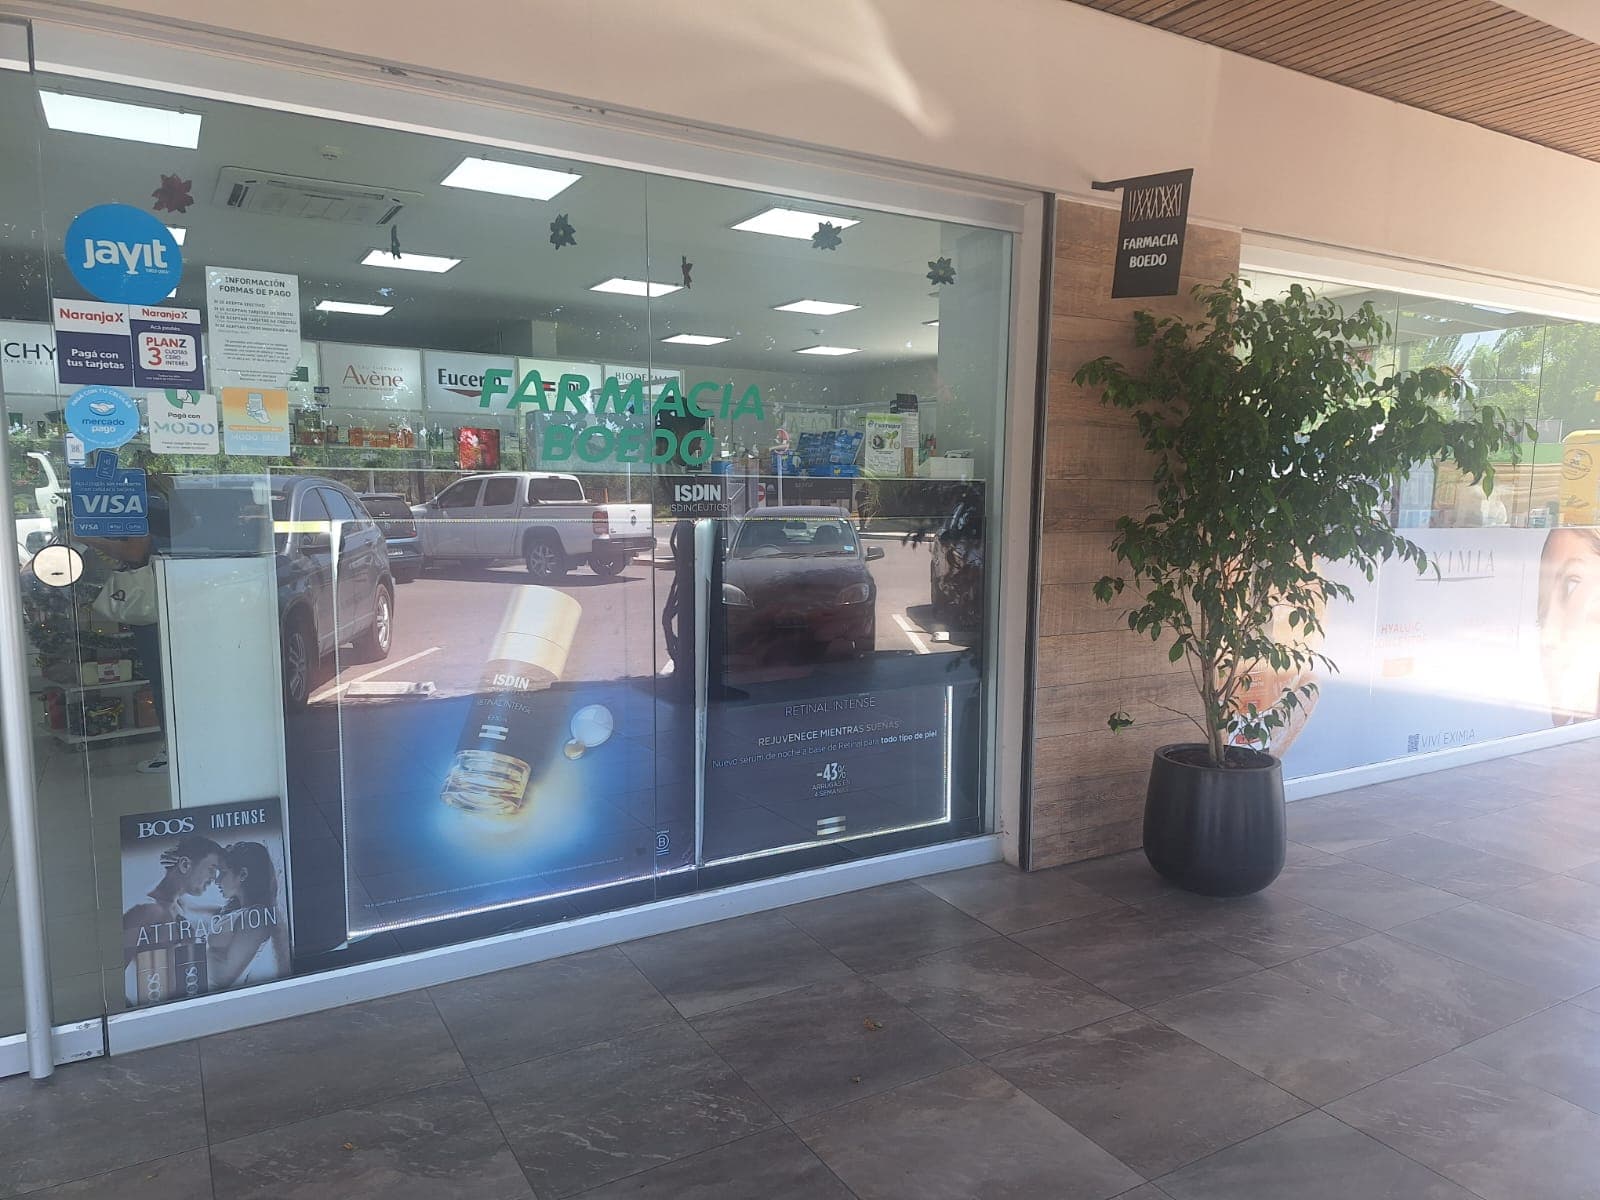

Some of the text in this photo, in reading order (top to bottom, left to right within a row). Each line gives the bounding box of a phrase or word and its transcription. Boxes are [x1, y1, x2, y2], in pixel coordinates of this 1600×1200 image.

[1123, 233, 1179, 250] FARMACIA
[1129, 253, 1167, 268] BOEDO
[219, 285, 292, 297] FORMAS DE PAGO
[225, 276, 285, 288] INFORMACIÓN
[71, 348, 119, 359] Pagá con
[148, 347, 162, 366] 3
[67, 358, 125, 369] tus tarjetas
[342, 364, 404, 388] Avène
[438, 368, 502, 388] Eucern
[479, 368, 765, 421] FARMACIA
[82, 418, 125, 426] mercado
[92, 426, 116, 434] pago
[153, 421, 216, 435] MODO
[542, 425, 715, 465] BOEDO
[674, 484, 721, 502] ISDIN
[75, 495, 143, 513] VISA
[669, 503, 728, 512] SDINCEUTICS
[1432, 549, 1494, 574] XIMIA
[493, 674, 529, 690] ISDIN
[785, 696, 876, 717] RETINAL INTENSE
[758, 730, 819, 746] REJUVENECE
[820, 724, 865, 738] MIENTRAS
[1443, 728, 1476, 745] EXIMIA
[712, 758, 738, 768] Nuevo
[881, 736, 898, 744] todo
[899, 733, 913, 742] tipo
[914, 732, 923, 740] de
[924, 730, 938, 739] piel
[816, 762, 847, 781] -43%
[137, 808, 266, 838] BOOS INTENSE
[136, 906, 277, 947] ATTRACTION
[147, 972, 160, 1001] OOS
[185, 966, 198, 996] OOS
